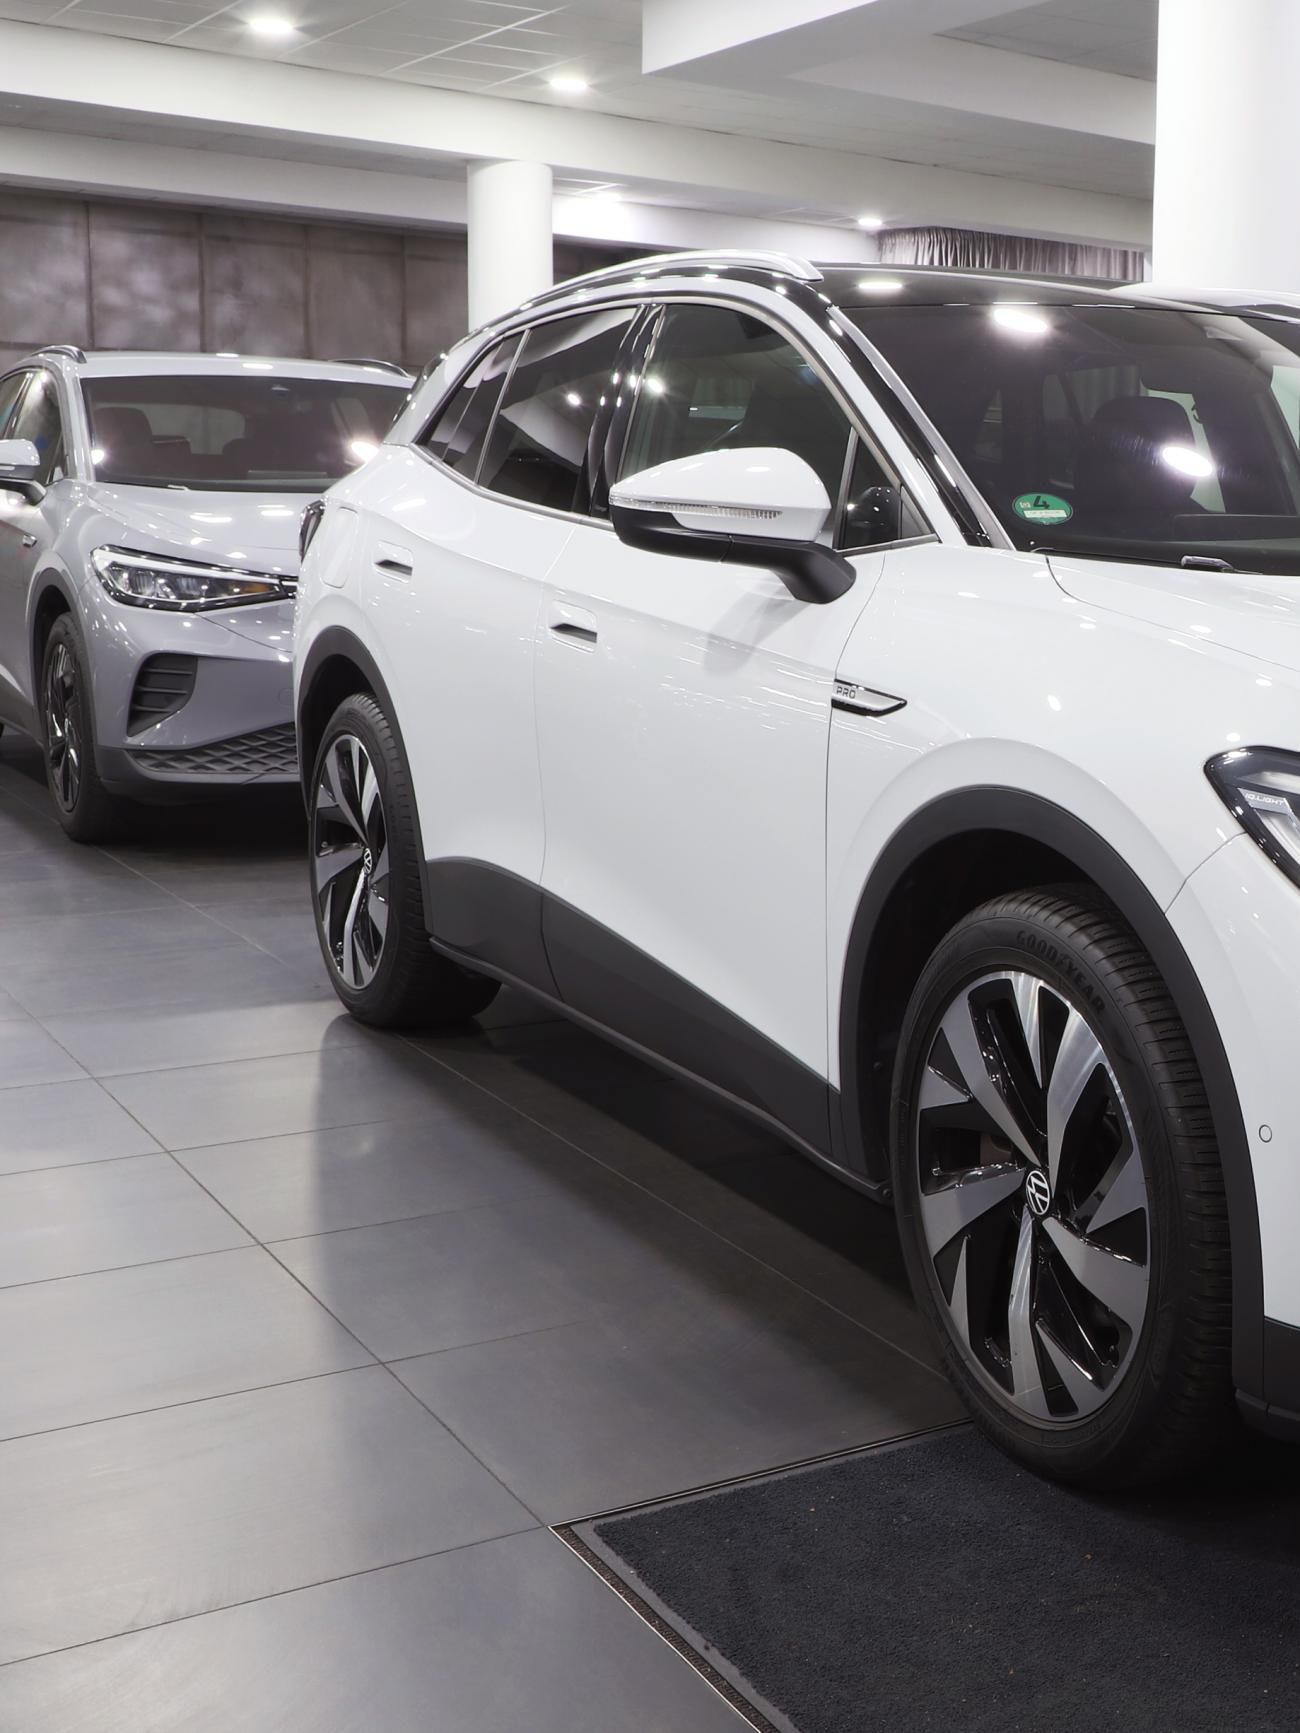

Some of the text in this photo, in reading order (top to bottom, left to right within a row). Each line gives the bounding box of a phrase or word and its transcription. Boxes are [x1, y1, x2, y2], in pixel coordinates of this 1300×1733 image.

[1033, 496, 1050, 509] 4
[836, 686, 856, 699] PRO
[1017, 930, 1105, 1013] GOODYEAR
